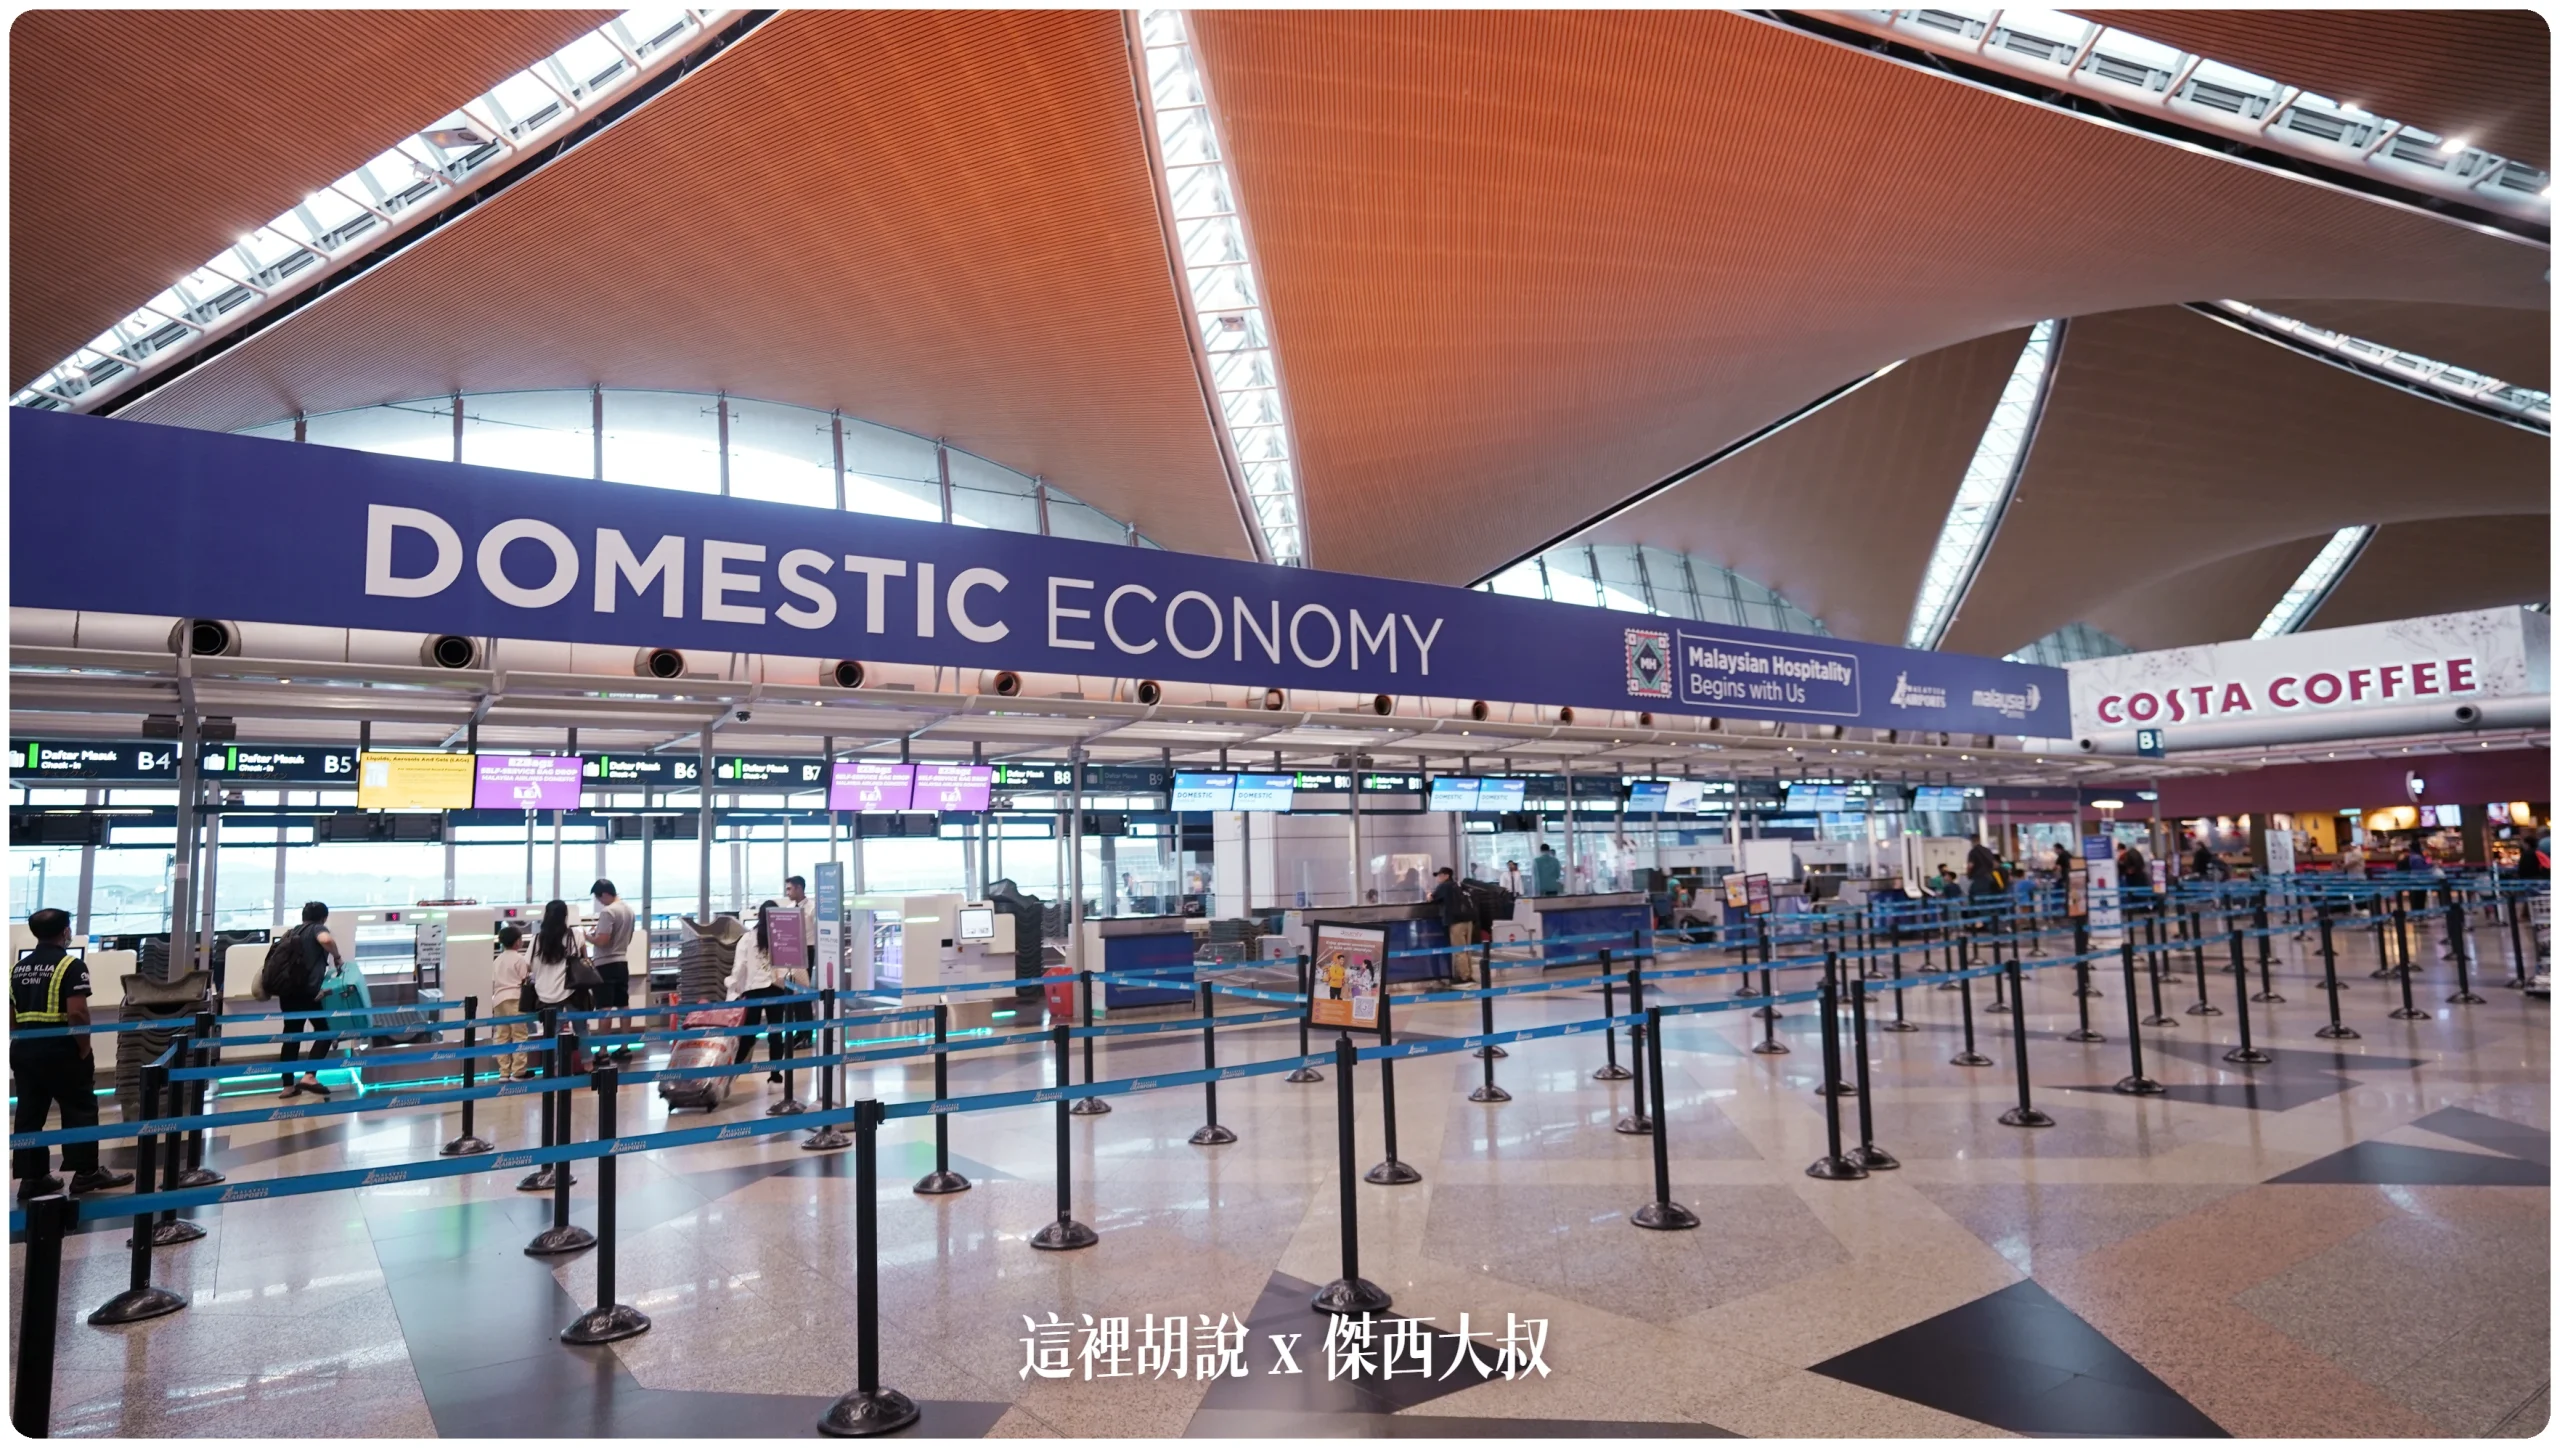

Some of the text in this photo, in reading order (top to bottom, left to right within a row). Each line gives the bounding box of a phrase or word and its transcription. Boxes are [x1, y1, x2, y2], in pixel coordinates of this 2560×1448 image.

[365, 503, 1444, 675] DOMESTIC ECONOMY
[1640, 657, 1657, 670] MH
[1688, 646, 1852, 686] Malaysian Hospitality
[1690, 673, 1806, 703] Begins with Us
[2097, 657, 2478, 724] COSTA COFFEE
[41, 749, 117, 761] Daftar Masuk
[138, 751, 171, 770] B4
[238, 753, 305, 764] Daftar Masuk
[324, 755, 352, 773] B5
[674, 762, 697, 779] B6
[802, 765, 822, 781] B7
[1054, 770, 1071, 785] B8
[1149, 773, 1163, 786] B9
[34, 964, 55, 972] KLIA
[501, 1158, 532, 1167] AIRPORTS
[372, 1174, 407, 1183] AIRPORTS
[231, 1191, 269, 1200] AIRPORTS
